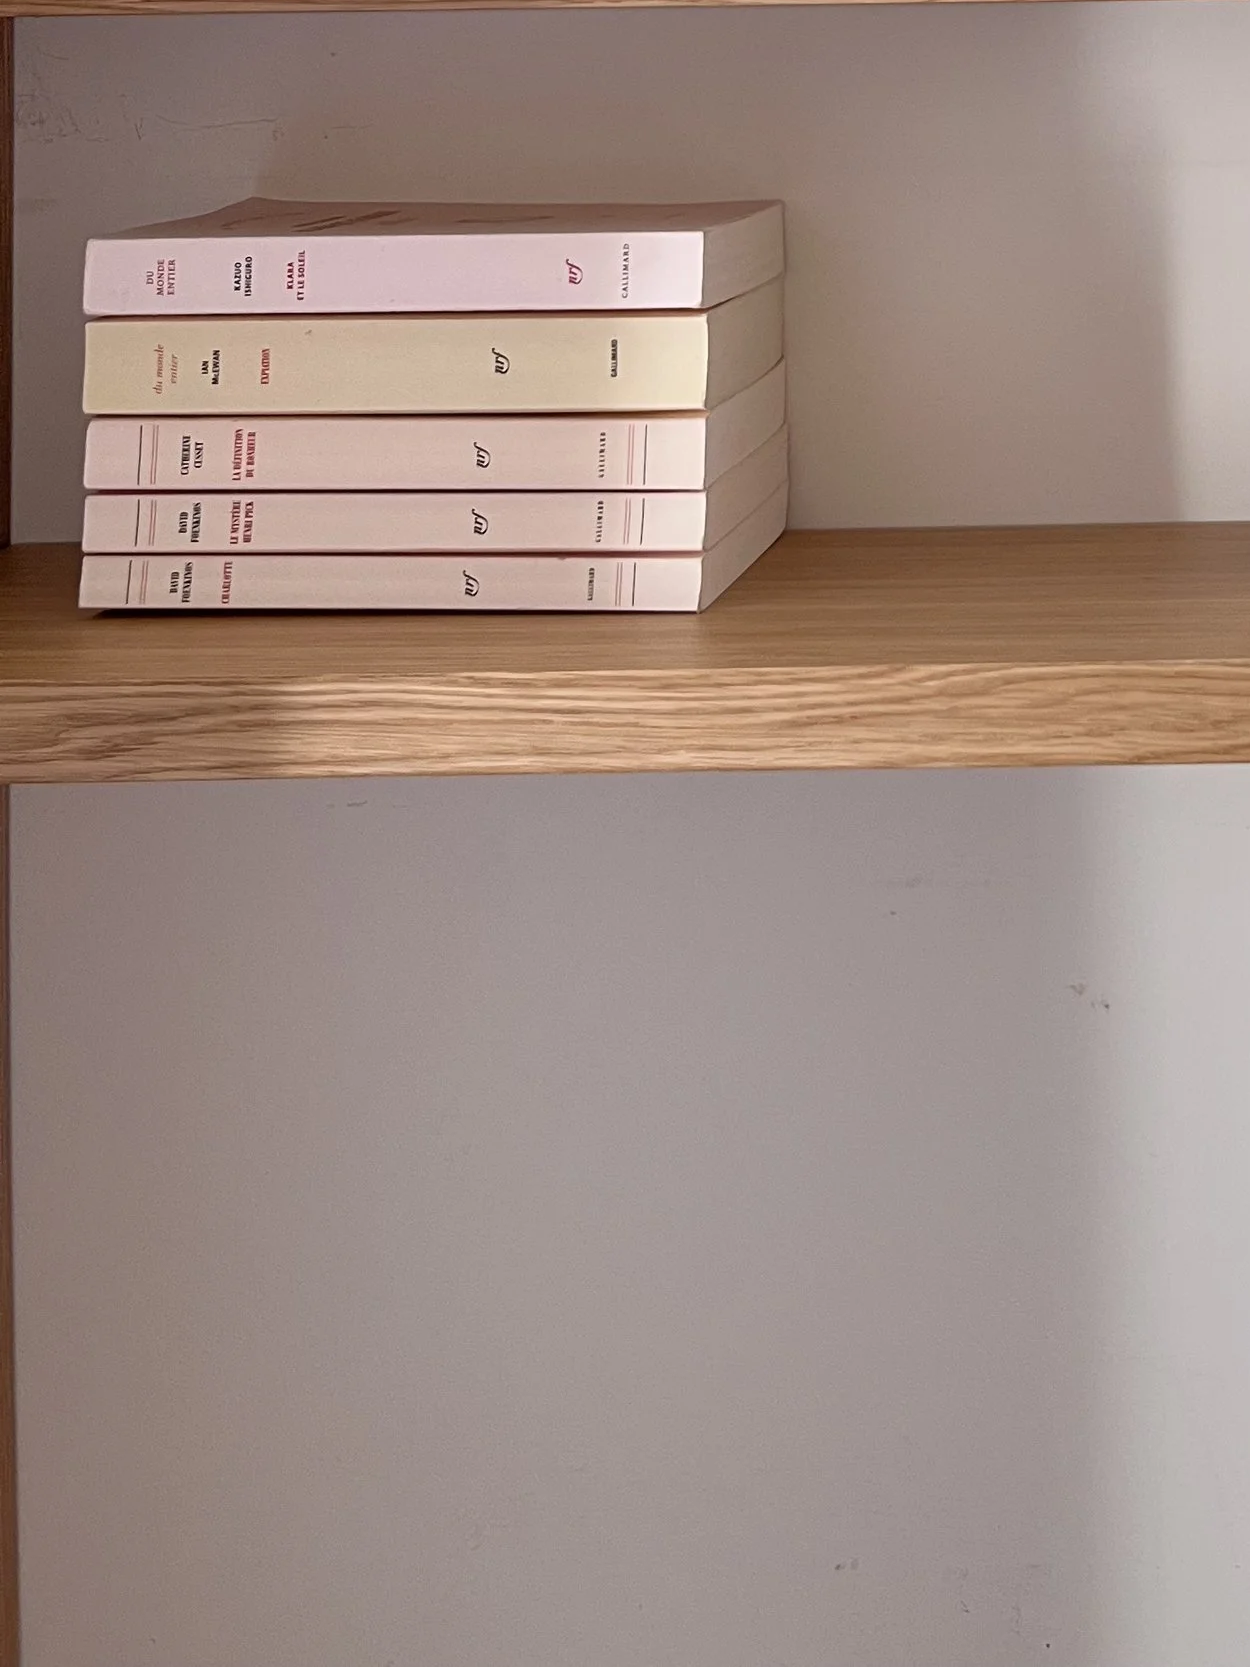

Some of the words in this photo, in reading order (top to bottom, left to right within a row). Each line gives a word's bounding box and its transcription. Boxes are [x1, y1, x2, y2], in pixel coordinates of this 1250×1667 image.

[146, 270, 155, 285] DU
[156, 259, 165, 296] MONDE
[166, 259, 176, 296] ENTIER
[233, 262, 242, 291] KAZUO
[244, 256, 253, 297] ISHIGURO
[286, 262, 295, 290] KLARA
[297, 250, 306, 278] SOLEIL
[565, 258, 584, 285] nrf
[621, 243, 630, 299] GALLIMARD
[297, 277, 305, 290] LE
[297, 291, 305, 301] ET
[153, 344, 165, 378] monde
[170, 354, 179, 384] entier
[201, 360, 209, 375] IAN
[491, 347, 510, 374] nrf
[152, 381, 163, 395] du
[180, 435, 191, 475] CATHERINE
[473, 441, 491, 469] nrf
[598, 432, 606, 478] GALLIMARD
[231, 471, 242, 481] LA
[245, 468, 254, 478] DU
[178, 511, 189, 534] DAVID
[190, 501, 202, 543] FOENKINOS
[244, 501, 254, 519] PICK
[471, 508, 489, 535] nrf
[595, 500, 604, 543] GALLIMARD
[229, 536, 239, 545] LE
[242, 520, 253, 543] HENRI
[169, 571, 180, 594] DAVID
[181, 561, 193, 603] FOENKINOS
[221, 561, 233, 604] CHARLOTTE
[462, 570, 480, 597] nrf
[587, 567, 595, 601] GALLIMARD
